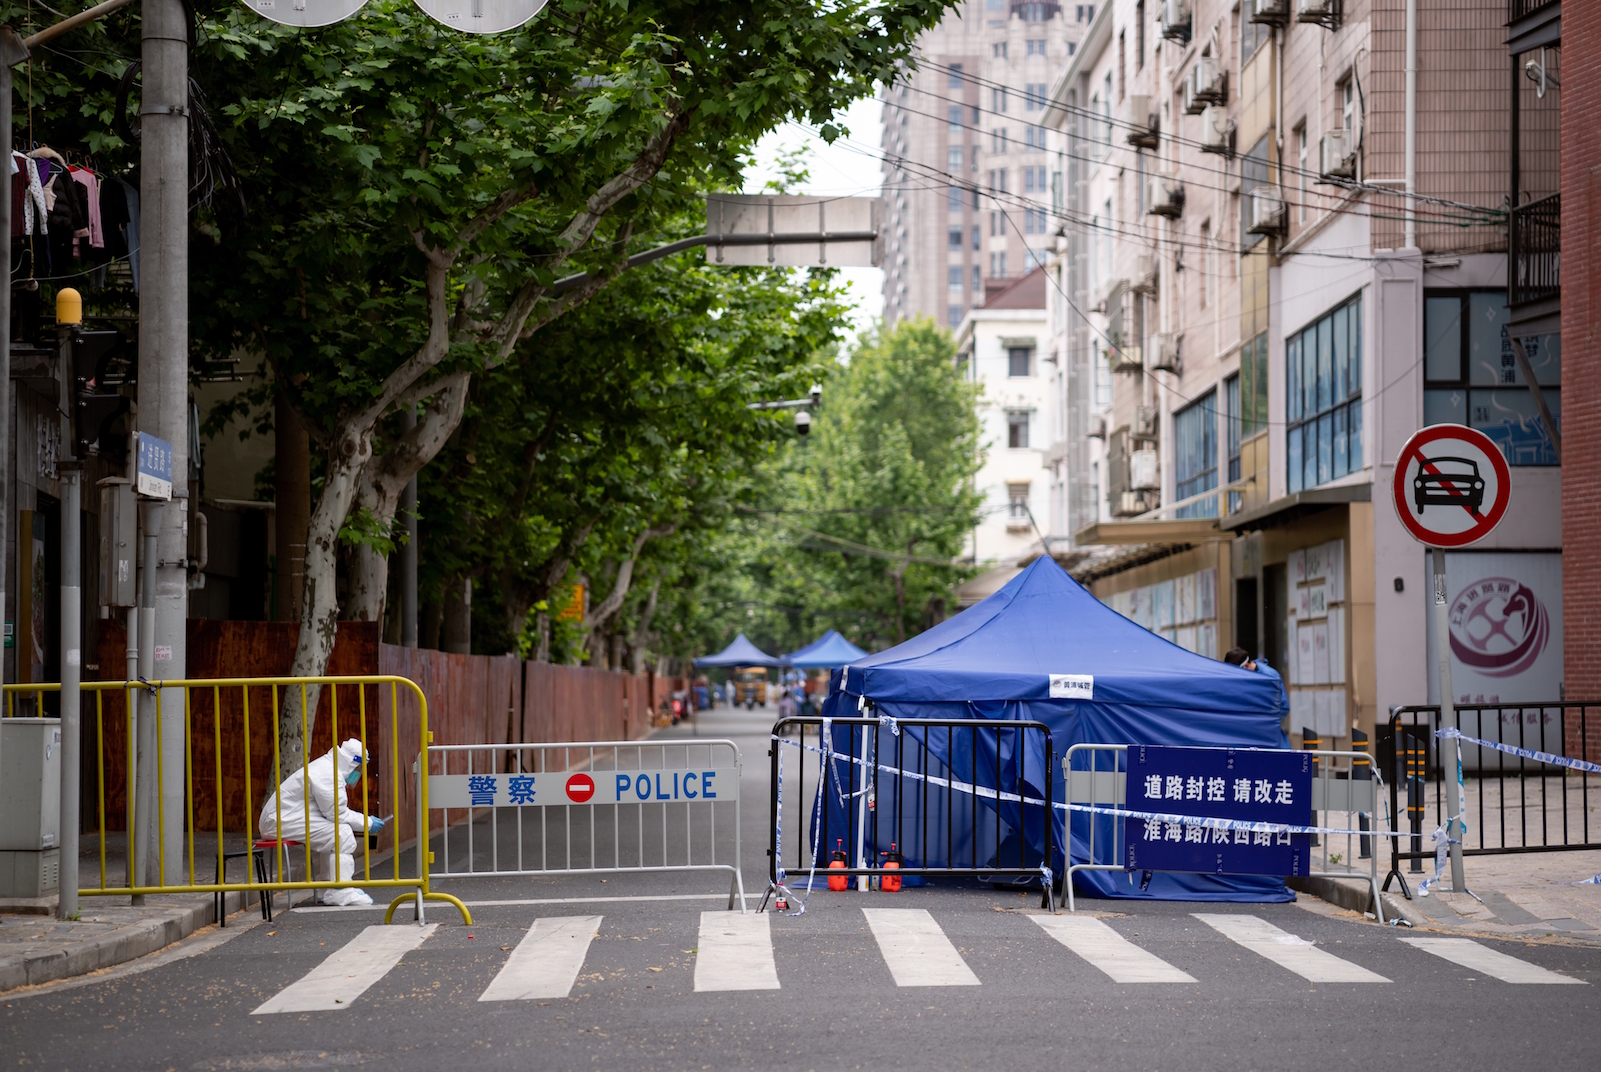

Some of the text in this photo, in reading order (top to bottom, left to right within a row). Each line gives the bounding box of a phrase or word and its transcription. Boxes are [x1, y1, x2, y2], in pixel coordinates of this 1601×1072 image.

[467, 775, 537, 806] 警察
[615, 771, 717, 801] POLICE
[1143, 774, 1294, 805] 道路封控 请改走
[1143, 817, 1292, 847] 淮海路/陕西路口
